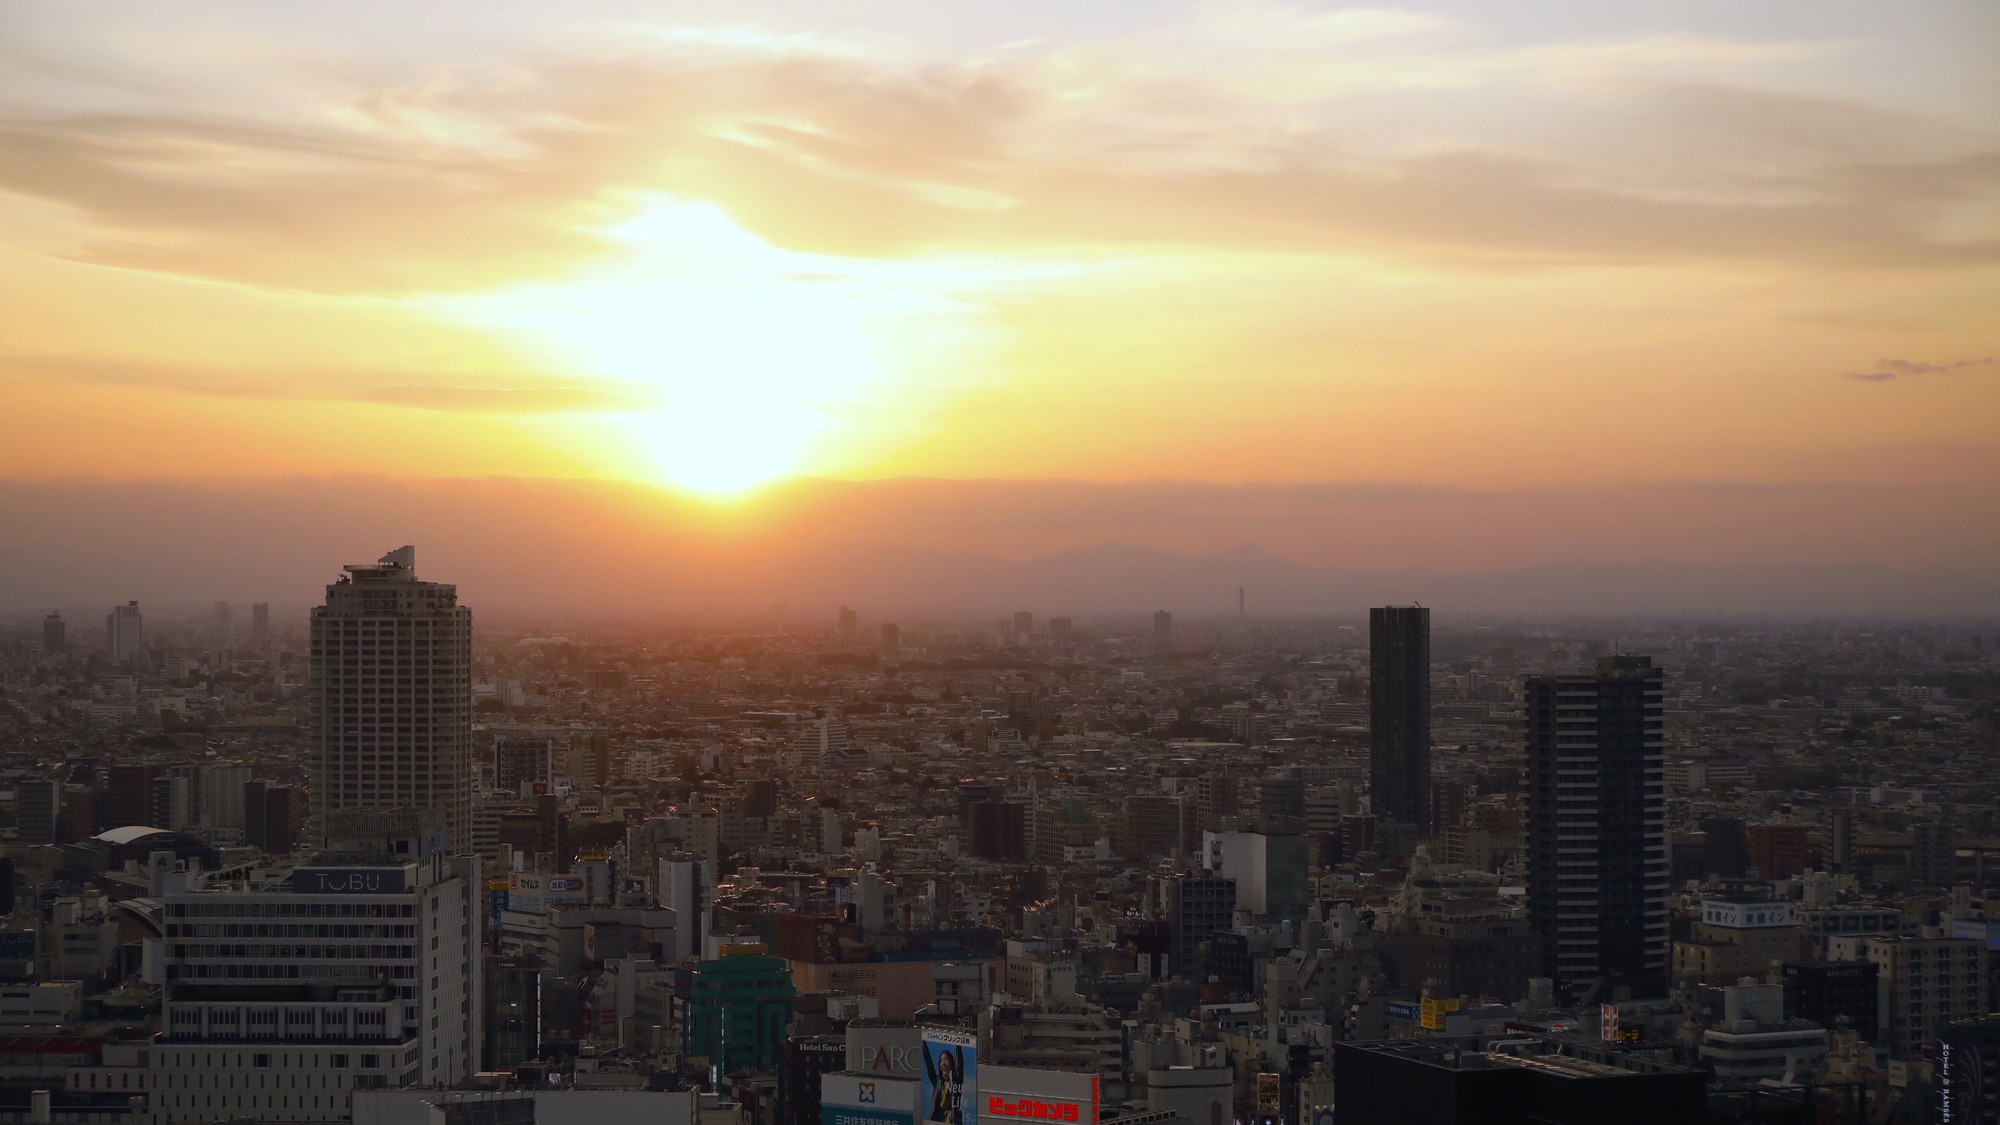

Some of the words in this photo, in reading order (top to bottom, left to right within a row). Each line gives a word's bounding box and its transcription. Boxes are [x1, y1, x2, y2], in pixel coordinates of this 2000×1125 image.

[316, 873, 380, 890] TOBU
[521, 879, 540, 890] セイムス
[552, 881, 580, 890] SEIMS
[1706, 910, 1736, 923] 東横イン
[1745, 911, 1785, 924] 東横イン
[927, 1032, 971, 1045] GMOクリック証券
[800, 1043, 821, 1051] Hotel
[822, 1043, 838, 1052] Sun
[952, 1096, 969, 1111] Life
[989, 1096, 1079, 1121] ビックカメラ
[1943, 1088, 1951, 1123] RAMSES
